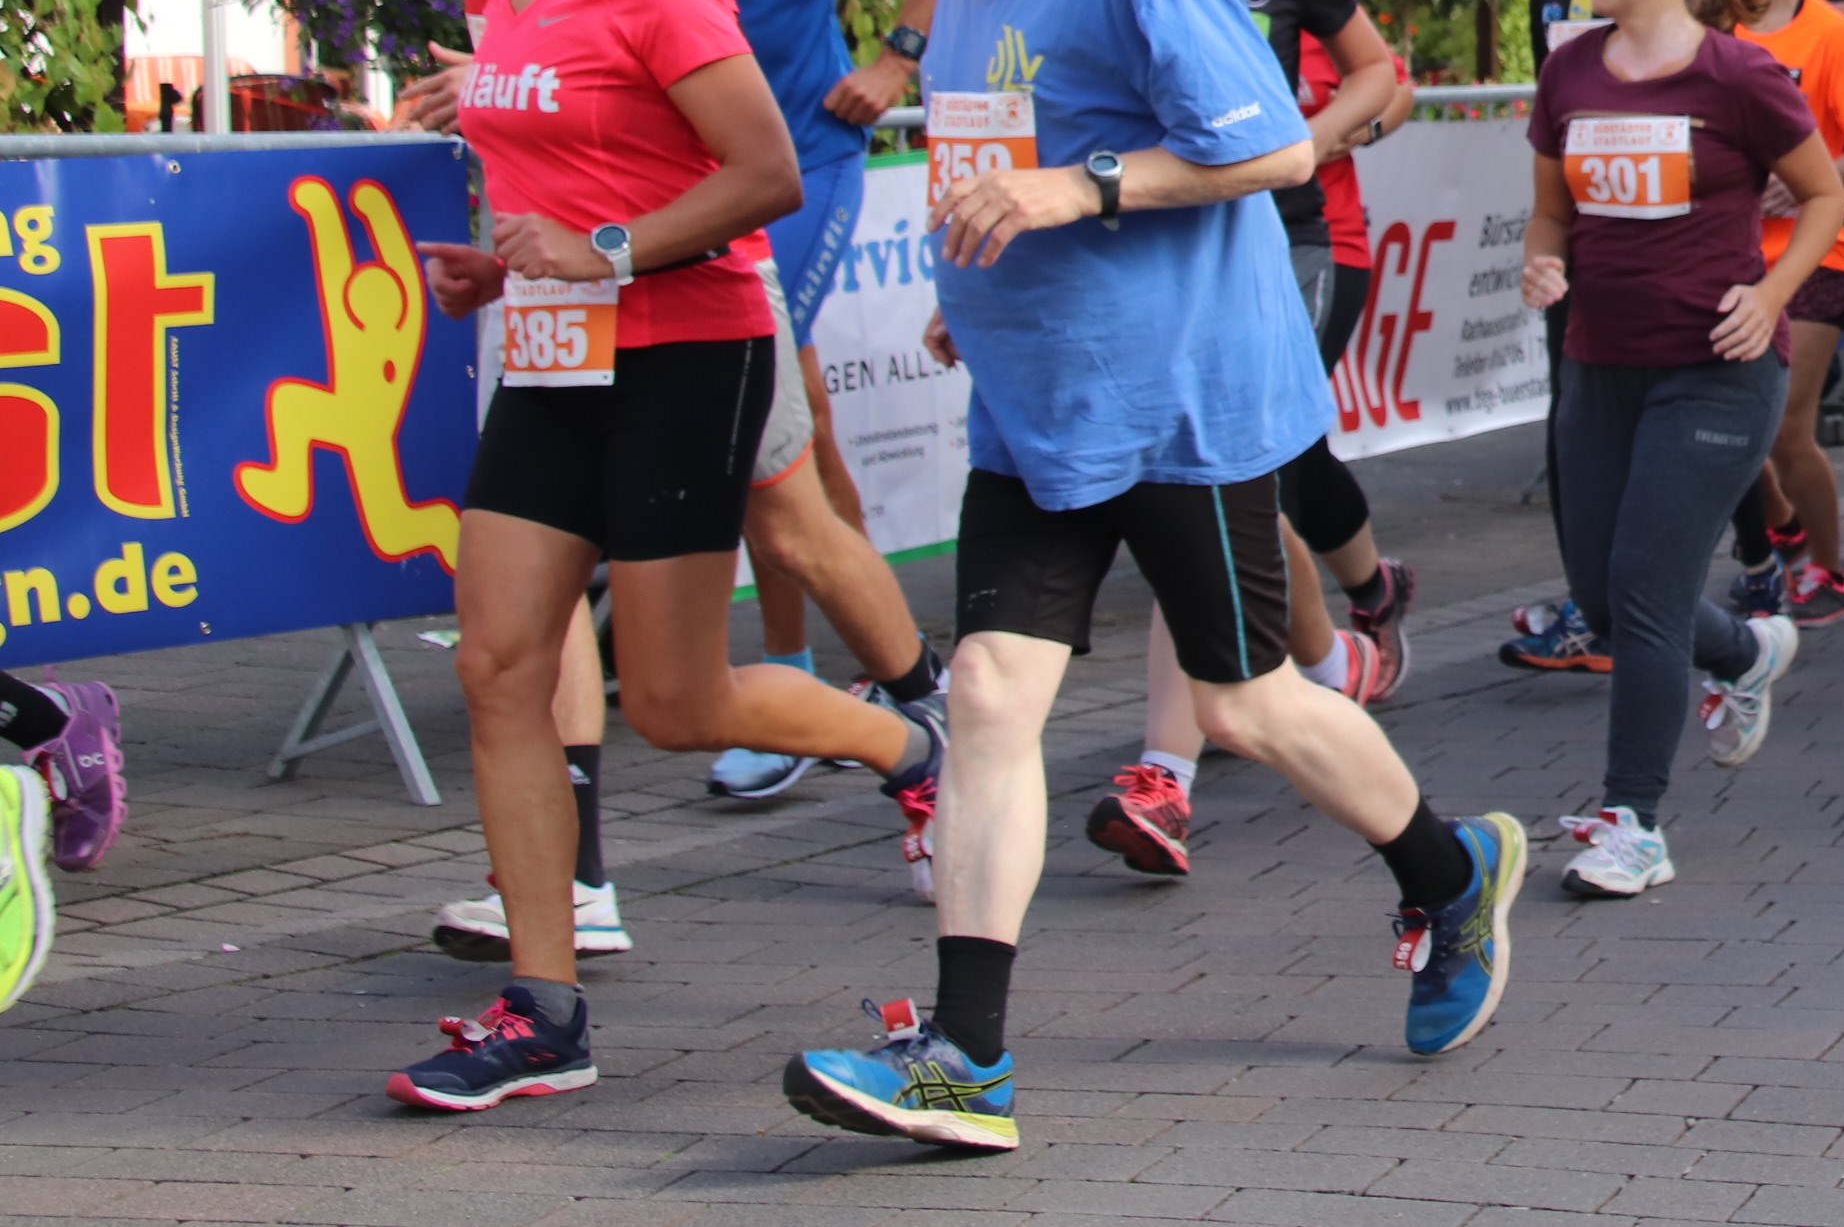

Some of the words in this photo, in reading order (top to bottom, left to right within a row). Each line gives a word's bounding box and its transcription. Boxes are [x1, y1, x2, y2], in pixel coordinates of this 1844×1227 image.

[1580, 156, 1663, 204] 301
[509, 308, 589, 370] 385
[823, 358, 875, 396] GEN
[0, 541, 198, 647] n.de
